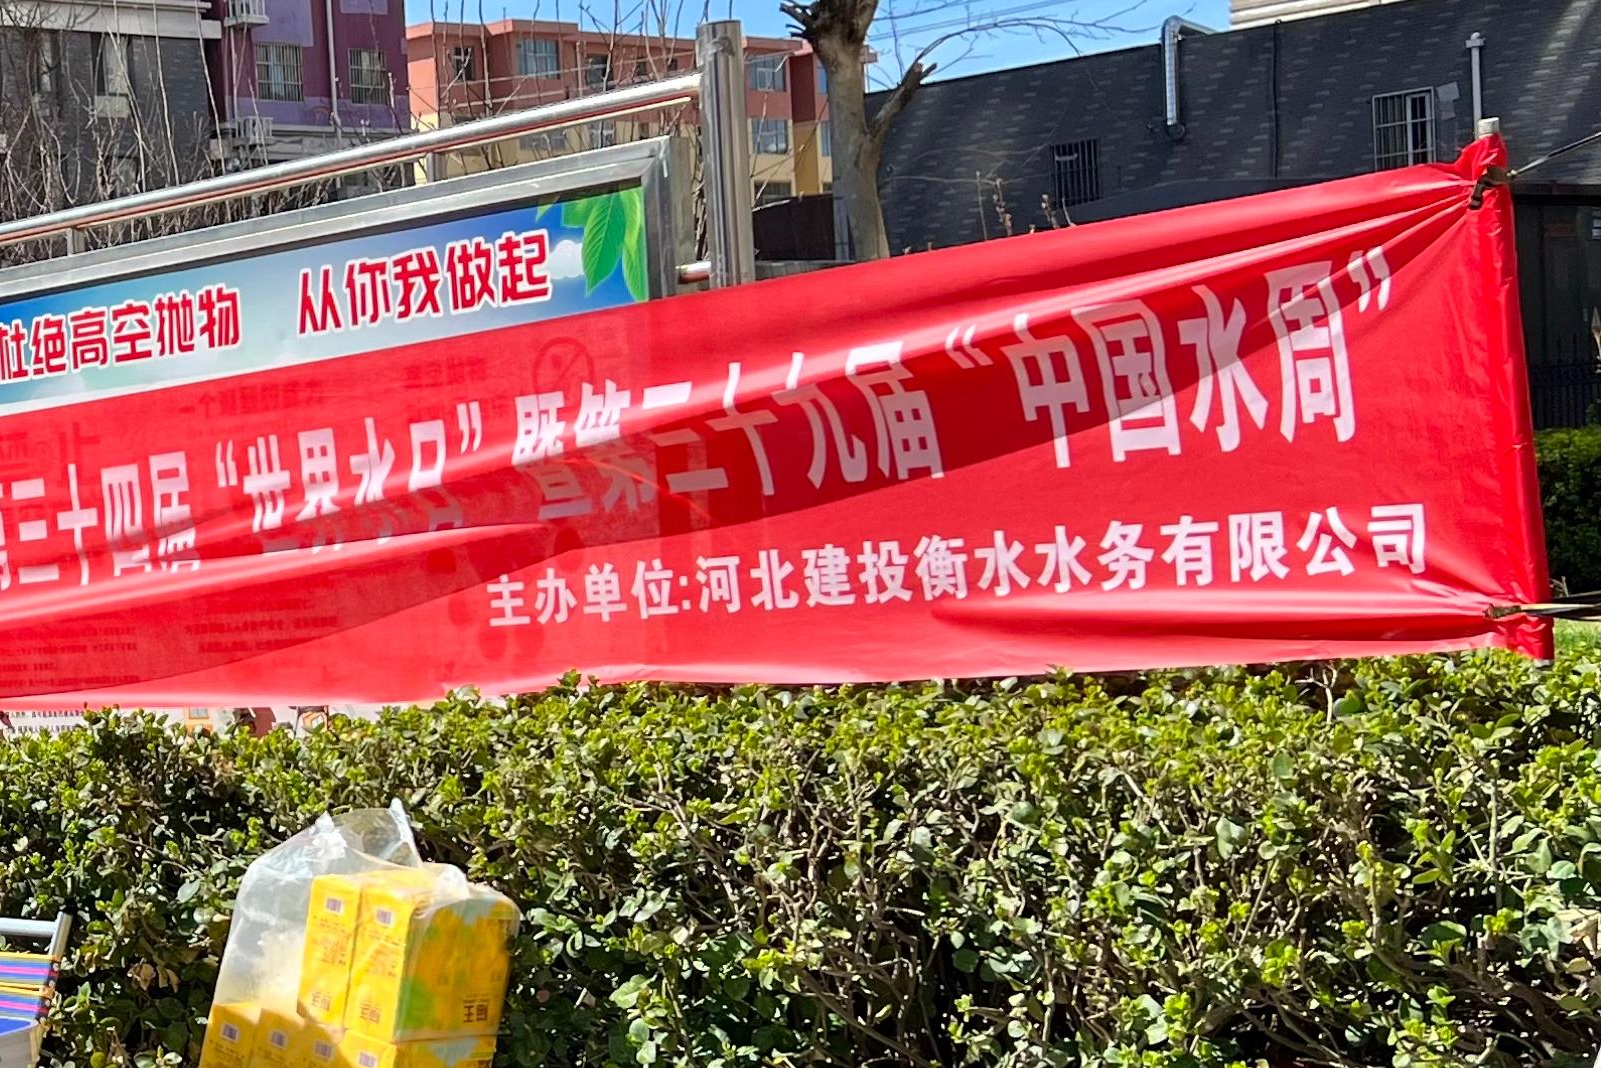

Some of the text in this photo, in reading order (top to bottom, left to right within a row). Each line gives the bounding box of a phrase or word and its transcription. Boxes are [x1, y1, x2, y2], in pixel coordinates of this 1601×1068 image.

[298, 229, 551, 332] 从你我做起
[489, 503, 1428, 629] 主办单位:河北建投衡水水务有限公司
